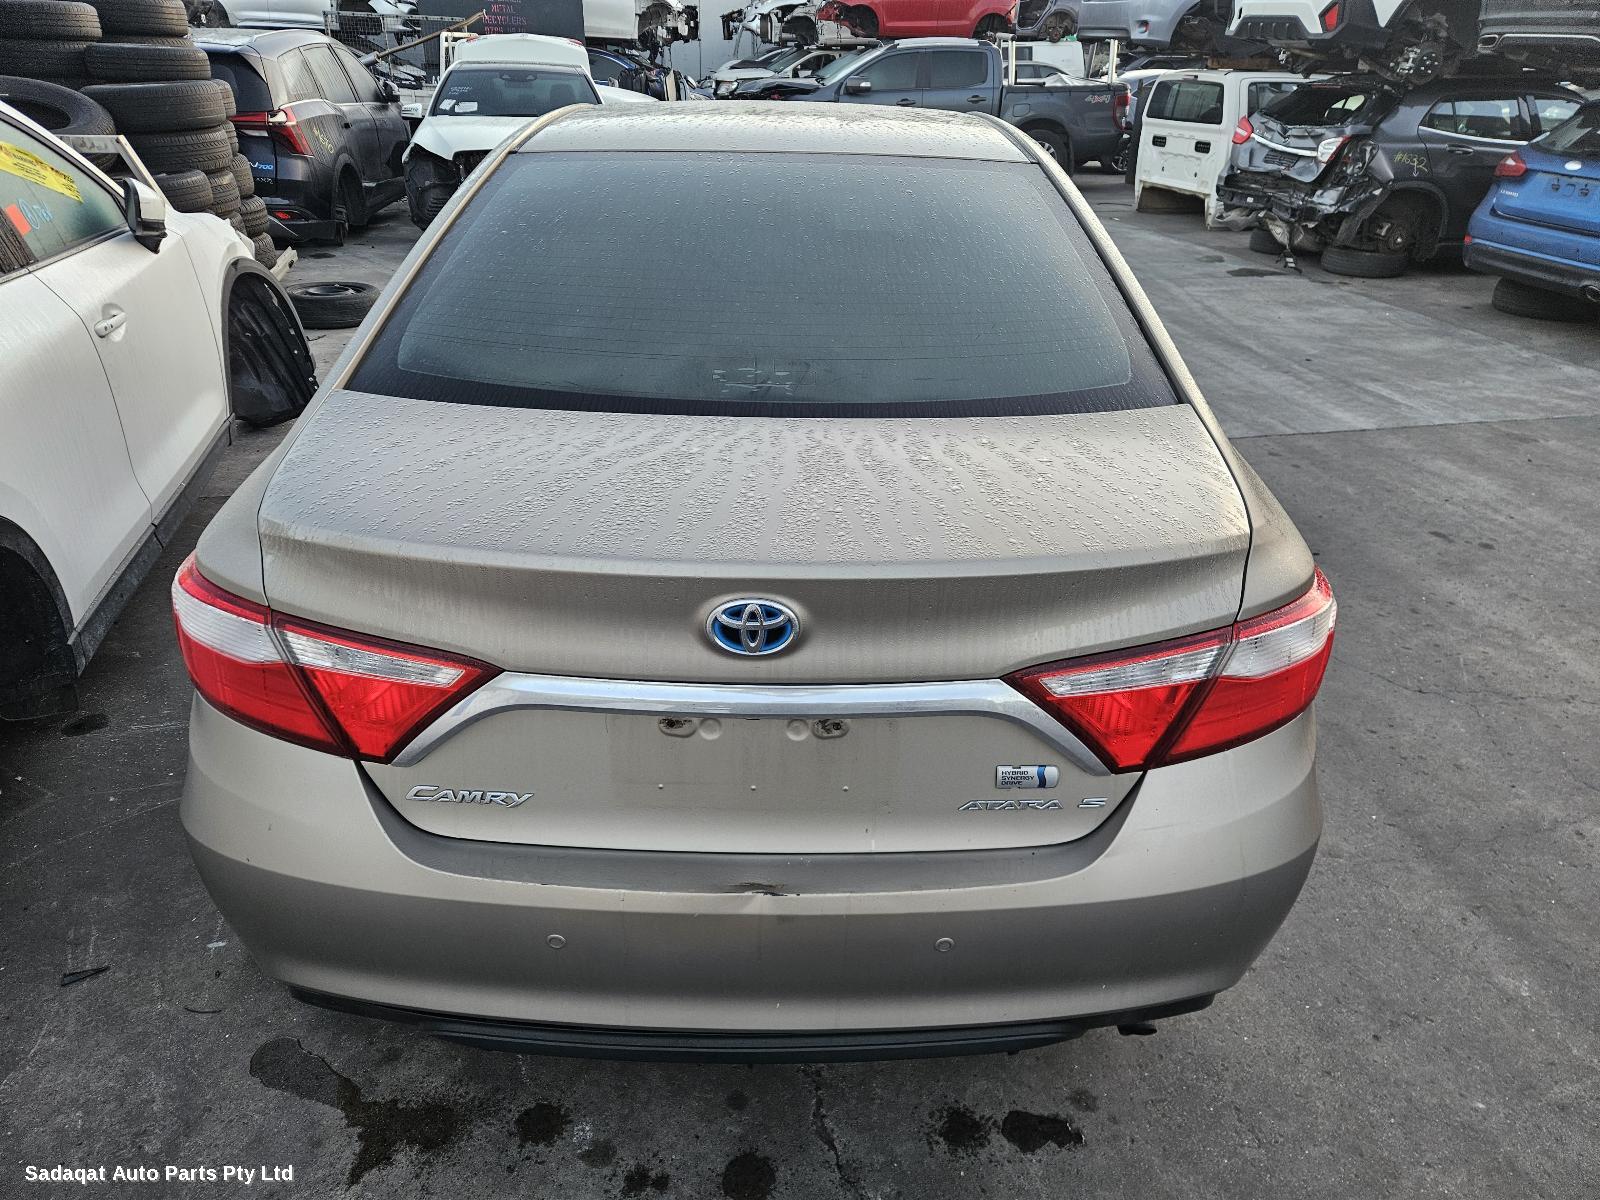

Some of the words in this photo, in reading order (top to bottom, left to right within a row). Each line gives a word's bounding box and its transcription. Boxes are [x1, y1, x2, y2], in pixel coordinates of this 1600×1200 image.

[405, 785, 534, 808] CAMRY
[958, 799, 1064, 811] ATARA
[1077, 797, 1109, 808] S
